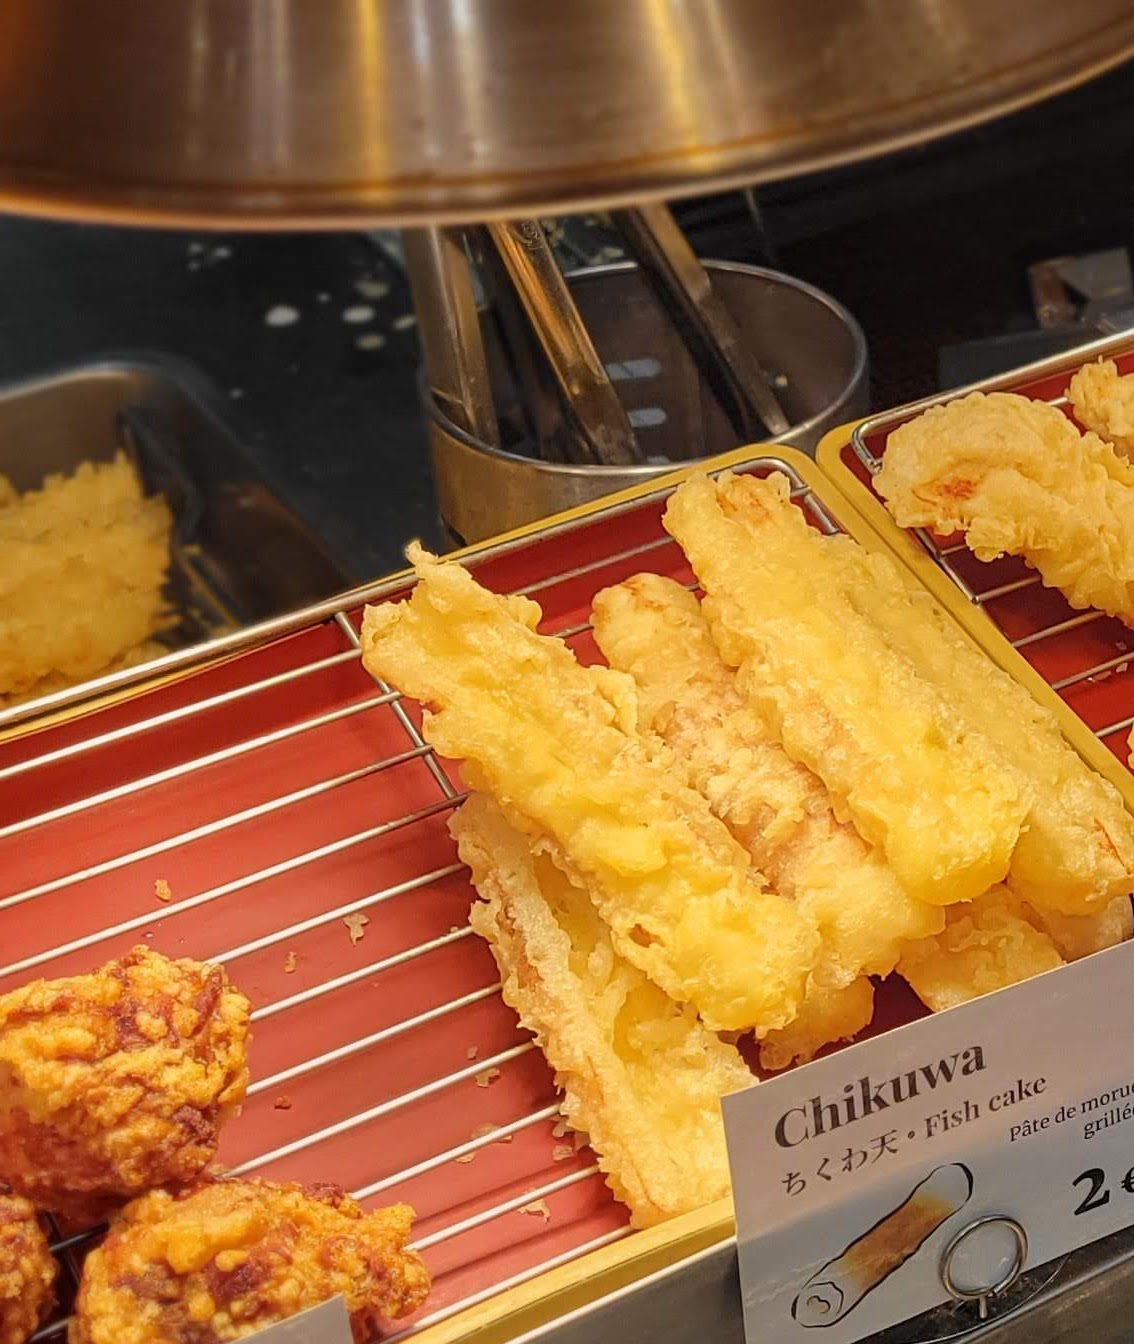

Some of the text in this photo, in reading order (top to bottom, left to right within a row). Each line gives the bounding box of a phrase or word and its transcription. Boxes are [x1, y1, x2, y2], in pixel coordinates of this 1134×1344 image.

[773, 1045, 988, 1150] Chikuwa
[782, 1128, 901, 1197] ちくわ天
[924, 1102, 982, 1138] Fish
[987, 1074, 1048, 1113] cake
[1008, 1118, 1050, 1143] Pâte
[1055, 1102, 1076, 1124] de
